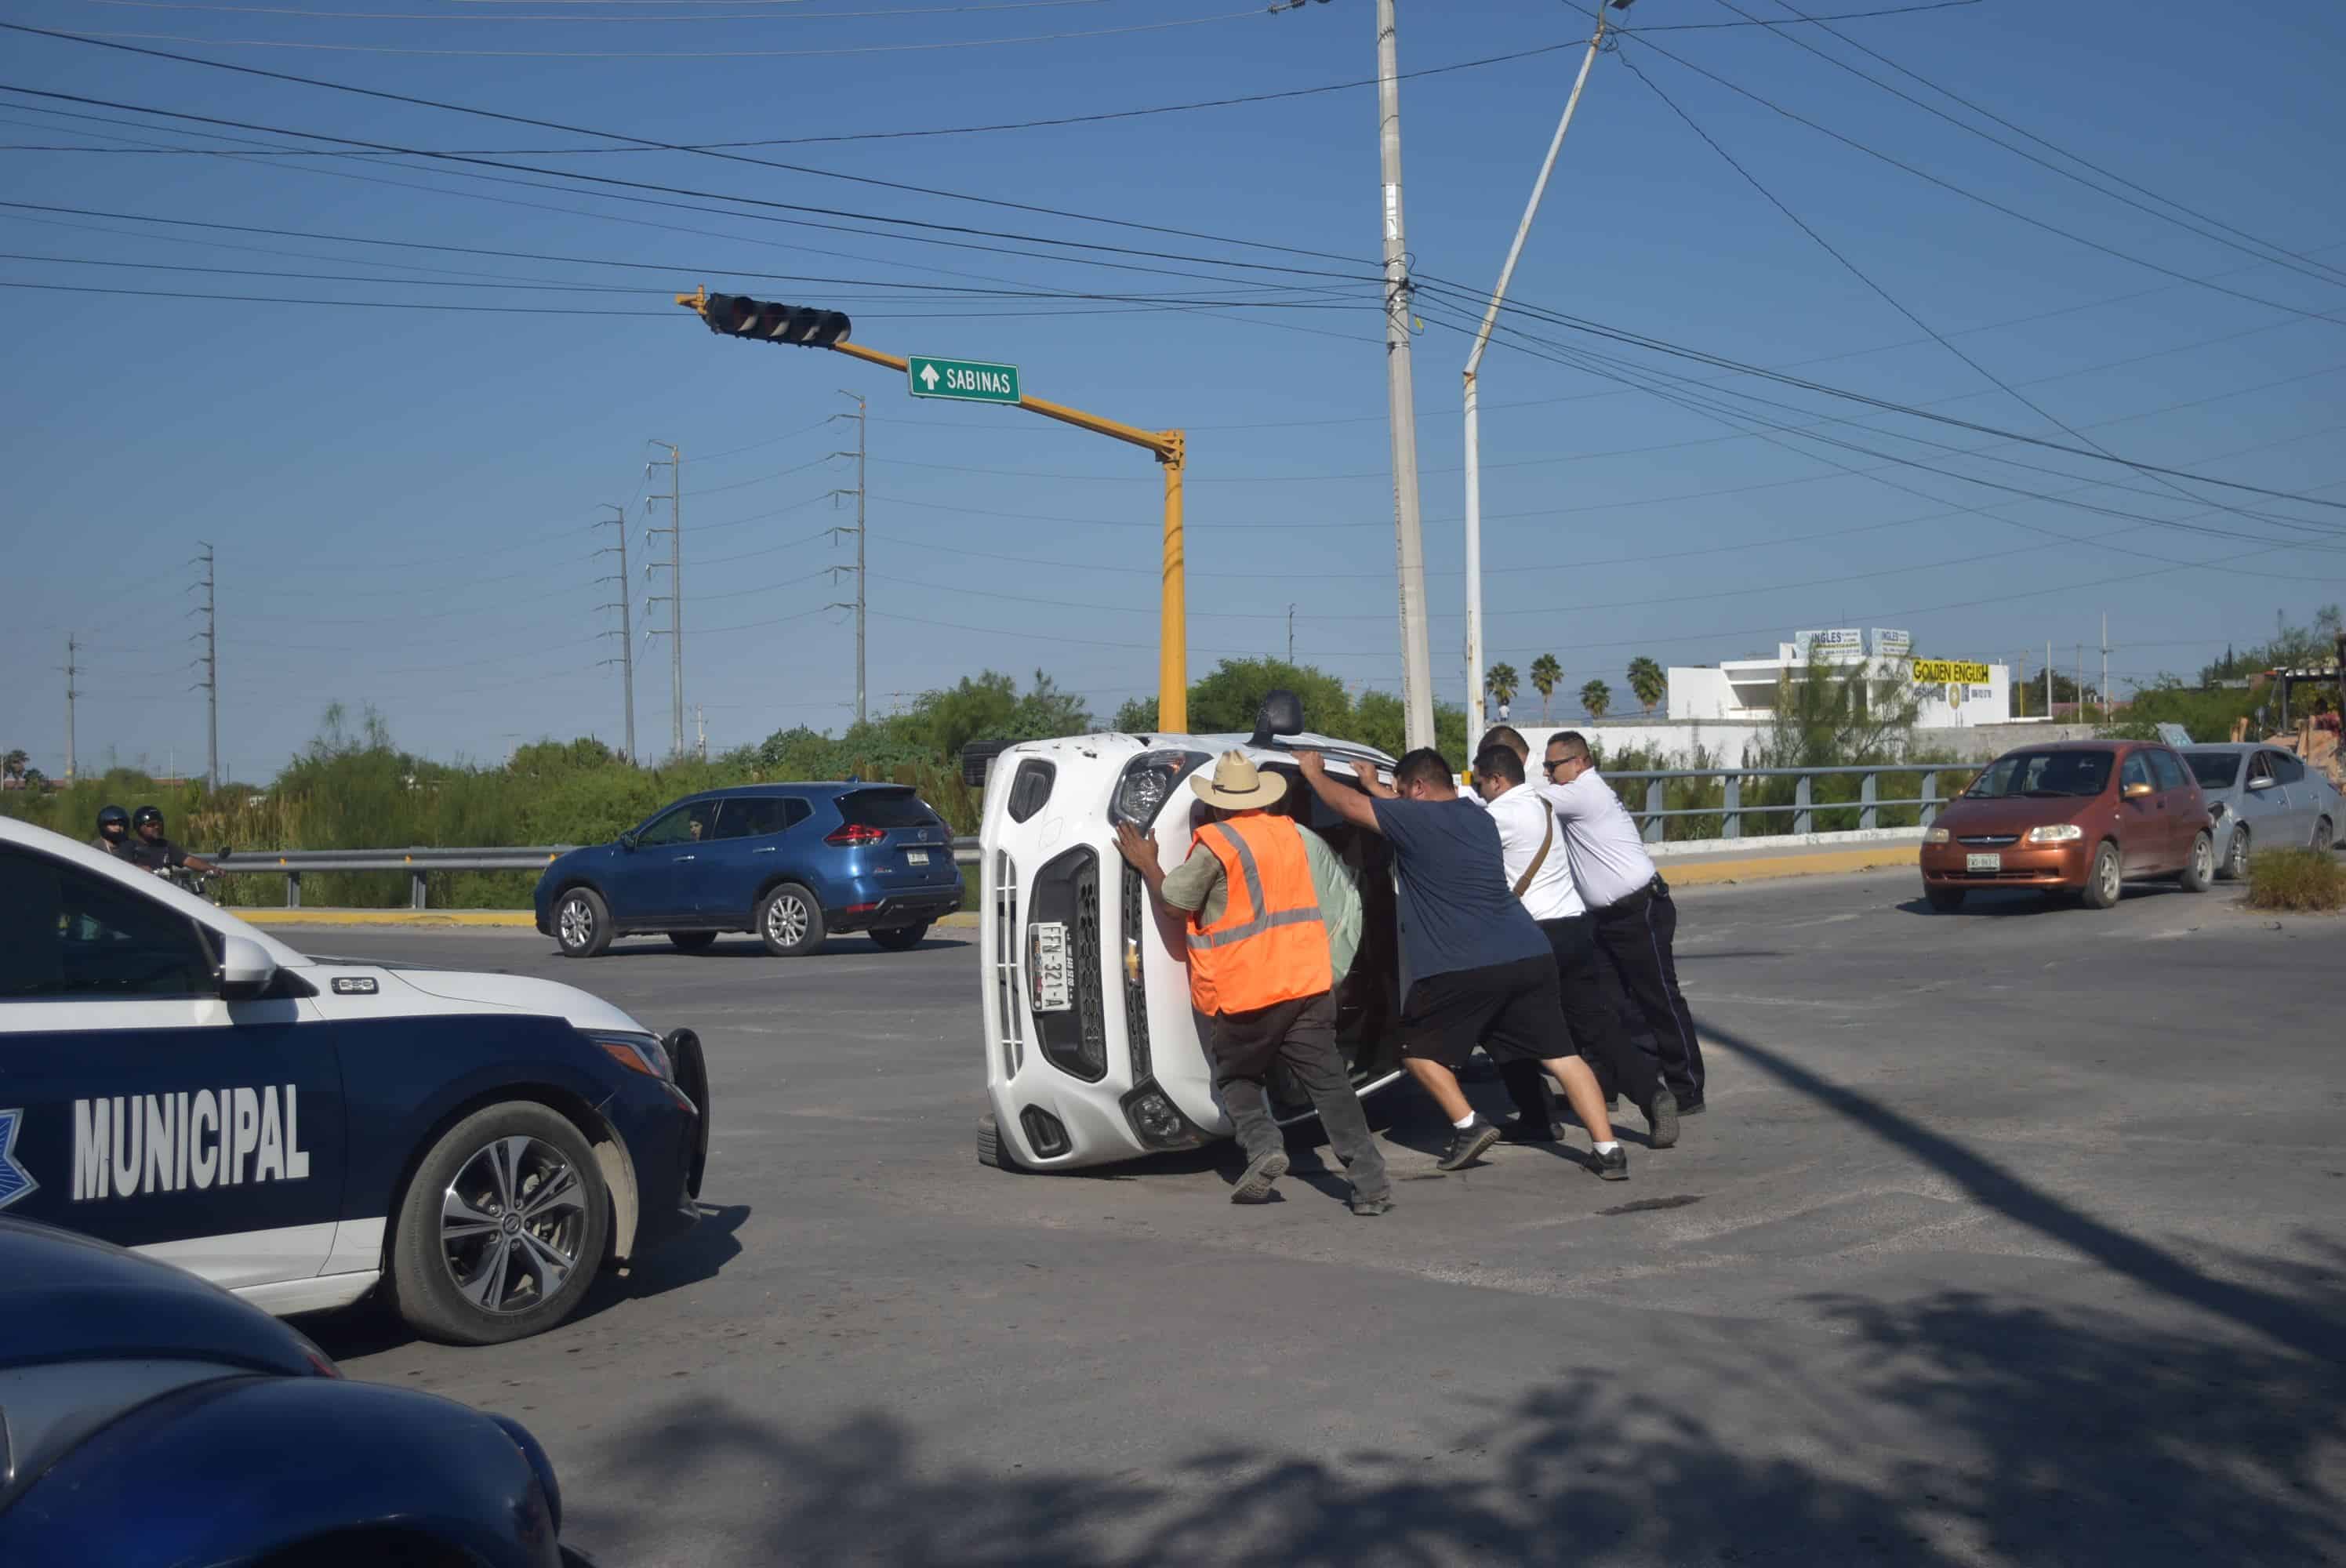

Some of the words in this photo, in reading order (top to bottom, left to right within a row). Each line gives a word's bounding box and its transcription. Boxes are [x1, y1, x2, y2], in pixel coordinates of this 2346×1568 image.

[946, 368, 1011, 394] SABINAS
[1913, 661, 1951, 681] GOLDEN
[1953, 664, 1989, 682] ENGLISH
[1040, 926, 1064, 1007] FFN-321-A
[73, 1083, 310, 1201] MUNICIPAL
